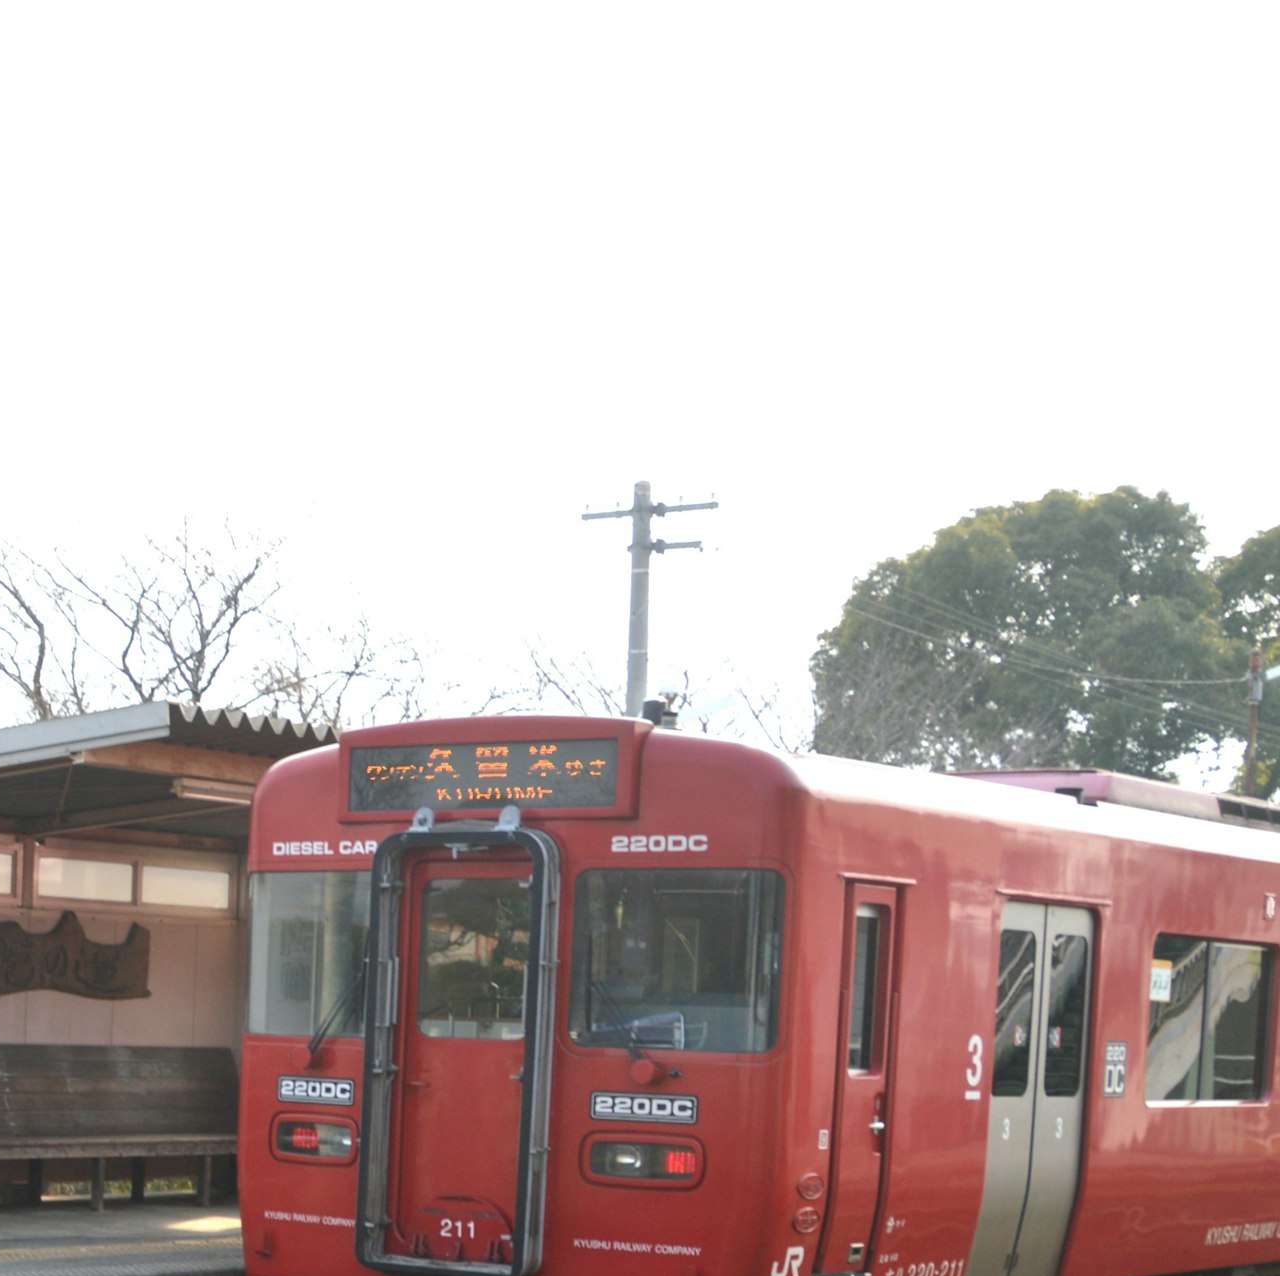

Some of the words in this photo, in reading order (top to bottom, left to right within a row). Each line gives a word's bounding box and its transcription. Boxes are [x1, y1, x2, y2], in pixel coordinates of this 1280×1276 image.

[272, 841, 334, 856] DIESEL
[339, 839, 378, 855] CAR
[611, 834, 708, 853] 220DC
[966, 1034, 983, 1087] 3
[1106, 1046, 1126, 1061] 220
[281, 1080, 351, 1099] 220DC
[1104, 1064, 1125, 1094] DC
[595, 1096, 693, 1117] 220DC
[1002, 1117, 1011, 1140] 3
[1055, 1117, 1064, 1139] 3
[264, 1210, 291, 1221] KYUSHU
[292, 1212, 321, 1225] RAILWAY
[322, 1216, 357, 1228] COMPANY
[440, 1218, 475, 1239] 211
[1205, 1225, 1243, 1246] KYUSHU
[574, 1239, 612, 1250] KYUSHU
[613, 1241, 653, 1254] RAILWAY
[654, 1244, 702, 1257] COMPANY
